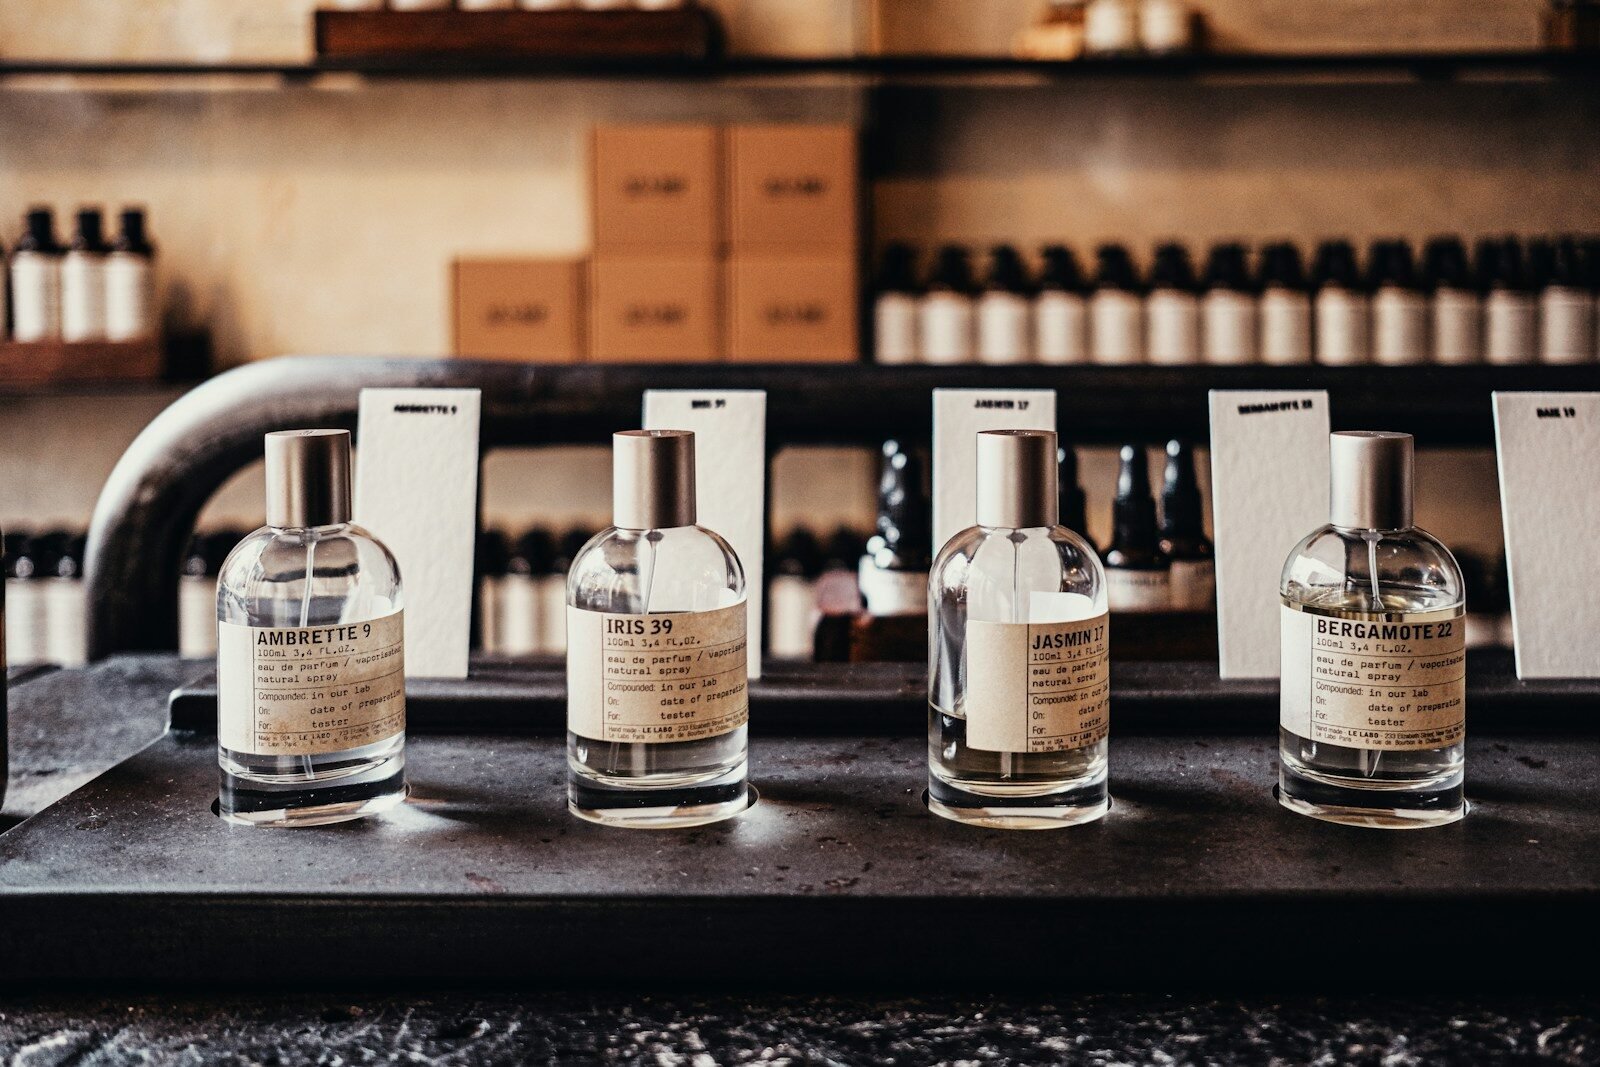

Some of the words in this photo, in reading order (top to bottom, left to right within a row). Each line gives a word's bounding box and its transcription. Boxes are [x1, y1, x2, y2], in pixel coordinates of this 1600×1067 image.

[607, 619, 645, 635] IRIS
[651, 619, 673, 634] 39
[1318, 620, 1433, 640] BERGAMOTE
[1438, 622, 1452, 638] 22
[258, 626, 358, 646] AMBRETTE
[363, 624, 371, 638] 9
[1033, 629, 1091, 649] JASMIN
[1095, 626, 1104, 641] 17
[608, 638, 635, 646] 100ml
[641, 638, 659, 648] 3,4
[666, 636, 701, 645] FL.OZ.
[1316, 638, 1343, 648] 100ml
[1350, 642, 1368, 652] 3,4
[1376, 644, 1412, 653] FL.OZ.
[258, 649, 286, 657] 100ml
[294, 649, 312, 658] 3,4
[608, 656, 625, 664] eau
[633, 654, 645, 663] de
[652, 652, 691, 664] parfum
[1034, 653, 1061, 661] 100ml
[1067, 651, 1081, 659] 3,4
[281, 663, 293, 671] de
[300, 661, 338, 672] parfum
[608, 666, 651, 675] natural
[659, 664, 691, 676] spray
[1057, 665, 1066, 673] de
[1316, 657, 1334, 665] eau
[1341, 658, 1353, 667] de
[1361, 661, 1402, 670] parfum
[258, 675, 299, 683] natural
[307, 672, 338, 683] spray
[1033, 677, 1071, 687] natural
[1077, 673, 1096, 683] spray
[1316, 666, 1359, 679] natural
[1368, 672, 1401, 682] spray
[331, 688, 348, 698] our
[355, 685, 370, 694] lab
[608, 683, 656, 693] Compounded:
[661, 680, 673, 691] in
[680, 680, 696, 690] our
[702, 677, 716, 688] lab
[1316, 681, 1363, 696] Compounded:
[1369, 688, 1381, 697] in
[1388, 689, 1406, 697] our
[1412, 689, 1429, 697] lab
[608, 697, 619, 705] On:
[661, 695, 684, 706] date
[691, 692, 700, 704] of
[1081, 692, 1088, 700] in
[258, 706, 270, 715] On:
[311, 705, 335, 714] date
[342, 700, 352, 710] of
[1316, 697, 1327, 705] On:
[1368, 703, 1393, 712] date
[1399, 704, 1411, 712] of
[608, 711, 621, 720] For:
[661, 709, 696, 720] tester
[1033, 711, 1045, 719] On:
[1079, 706, 1094, 715] date
[1316, 711, 1327, 720] For:
[1368, 718, 1405, 726] tester
[259, 721, 272, 730] For:
[312, 718, 348, 728] tester
[1033, 726, 1046, 734] For:
[1080, 717, 1101, 728] tester
